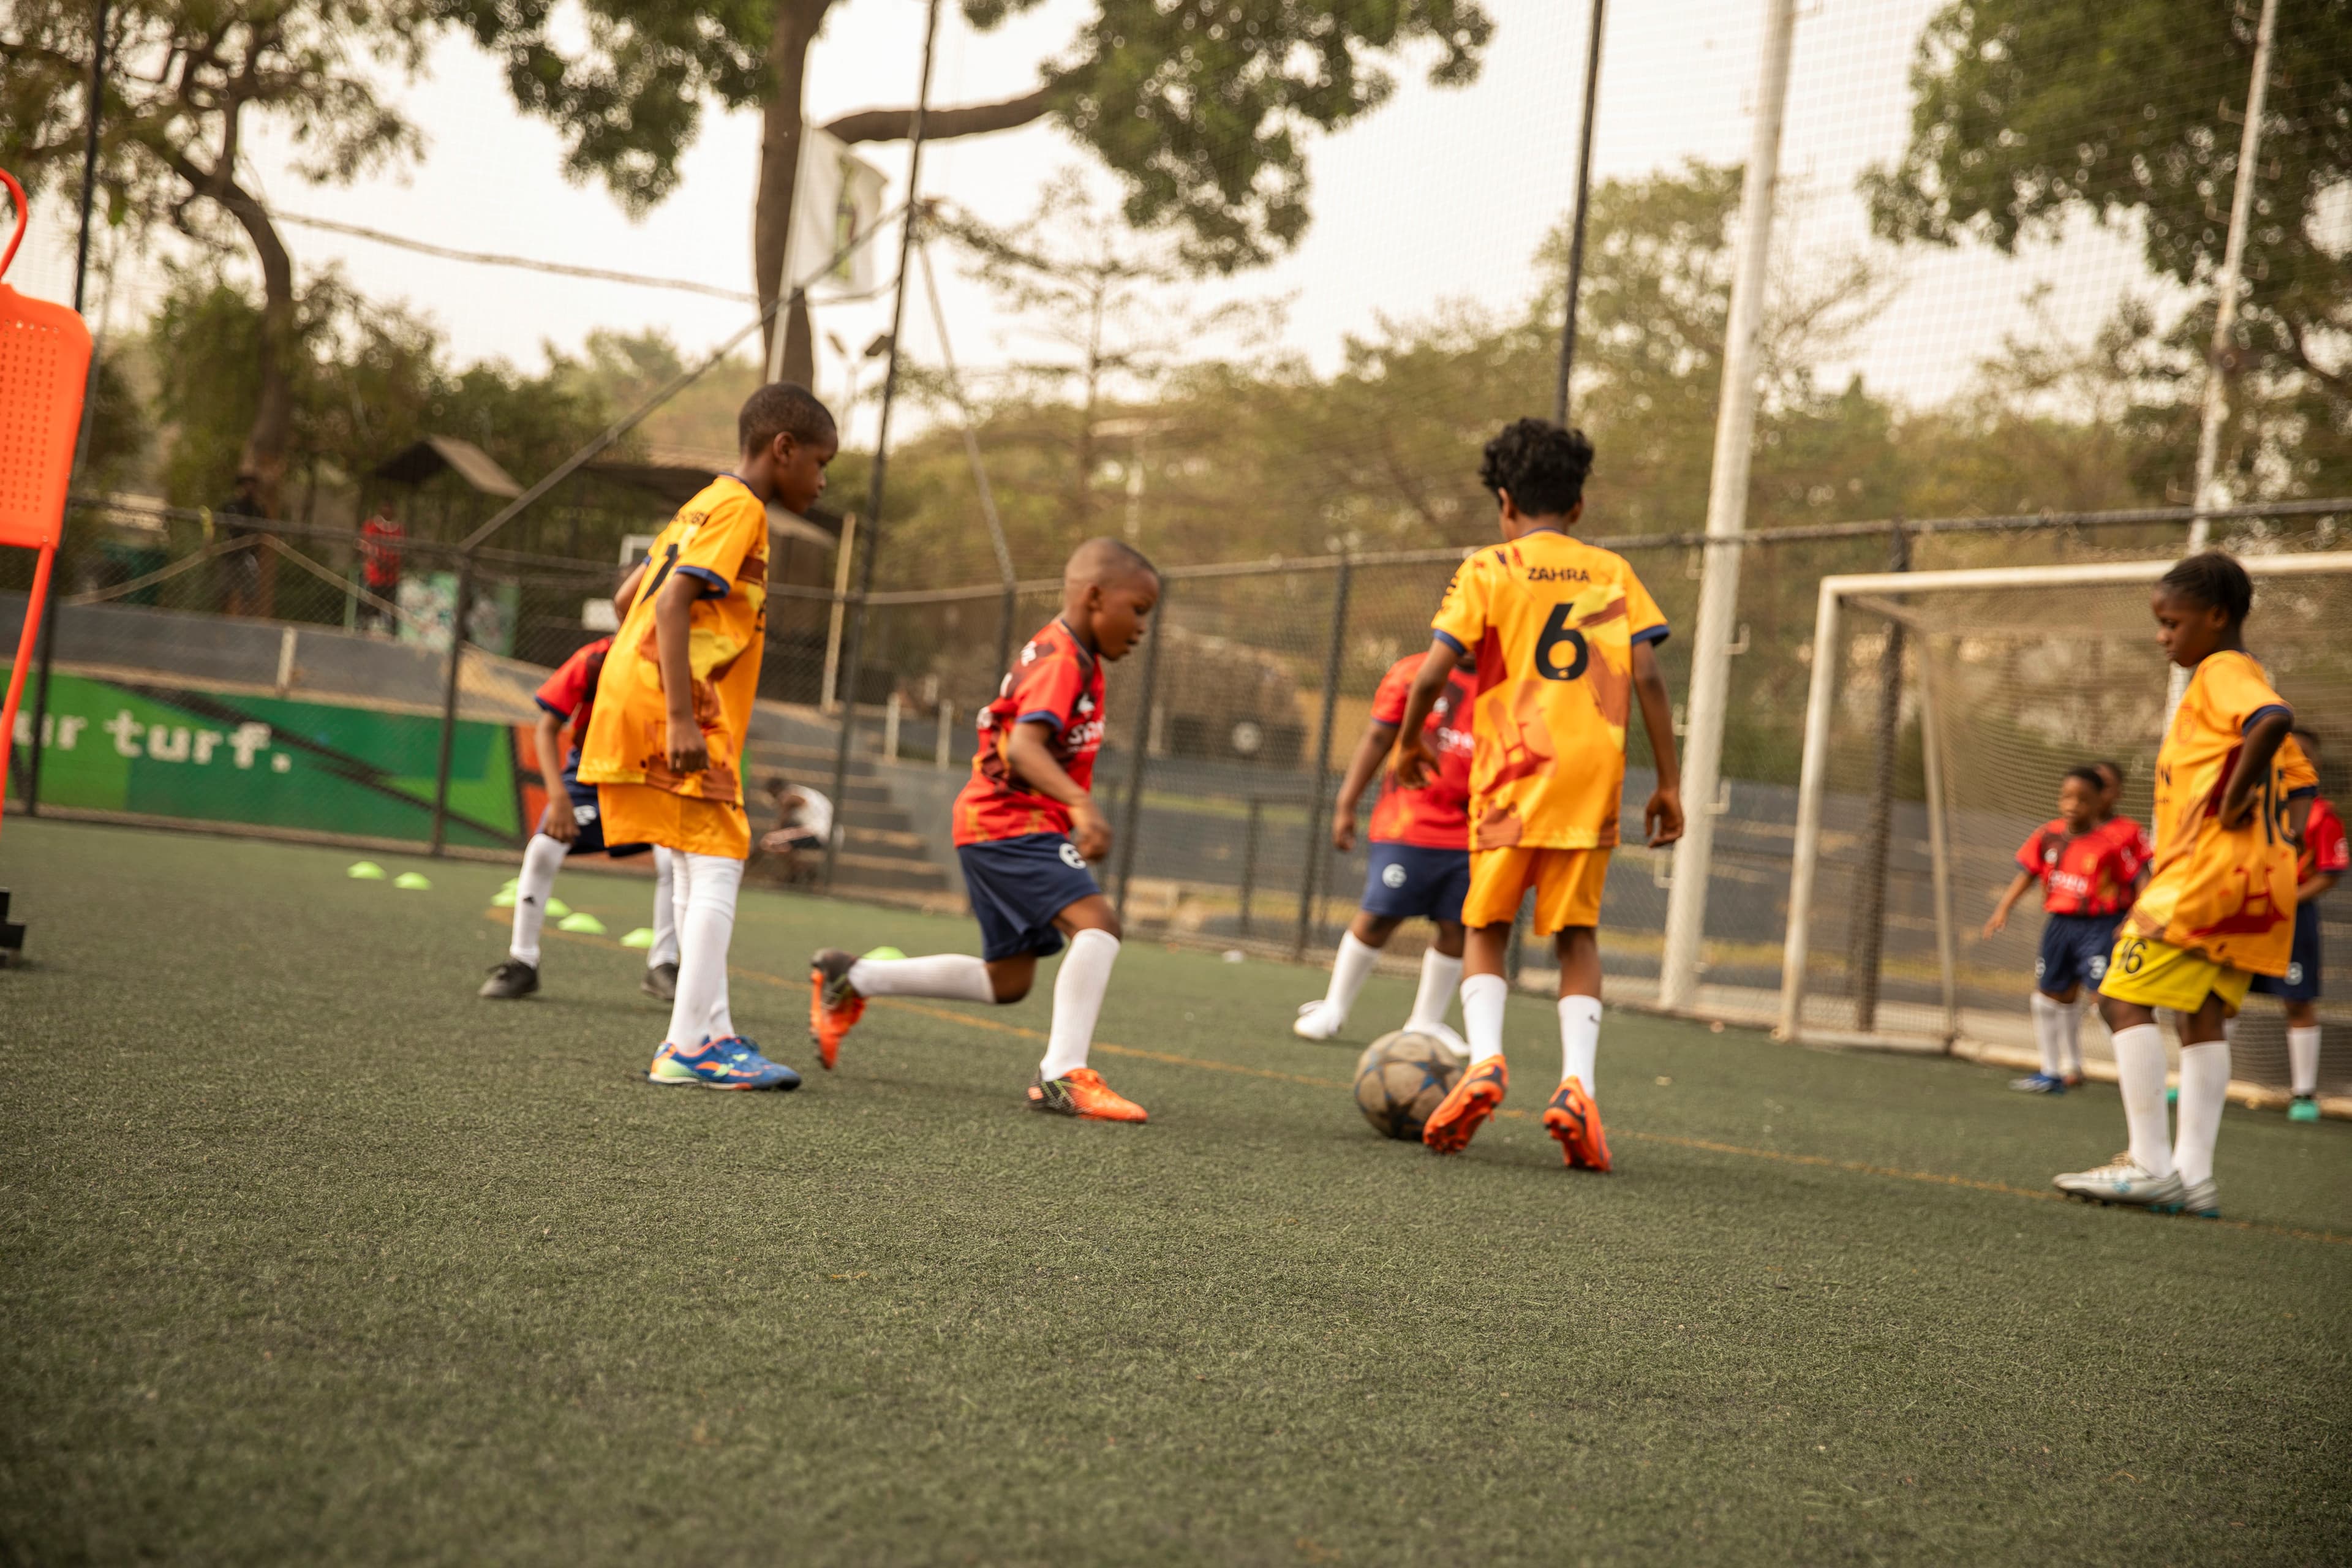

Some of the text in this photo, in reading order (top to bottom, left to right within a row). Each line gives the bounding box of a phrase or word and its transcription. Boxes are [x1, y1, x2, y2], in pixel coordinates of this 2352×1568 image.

[1528, 567, 1591, 582] ZAHRA
[1534, 602, 1589, 682] 6
[0, 709, 292, 773] ur turf.
[2117, 938, 2147, 974] 16
